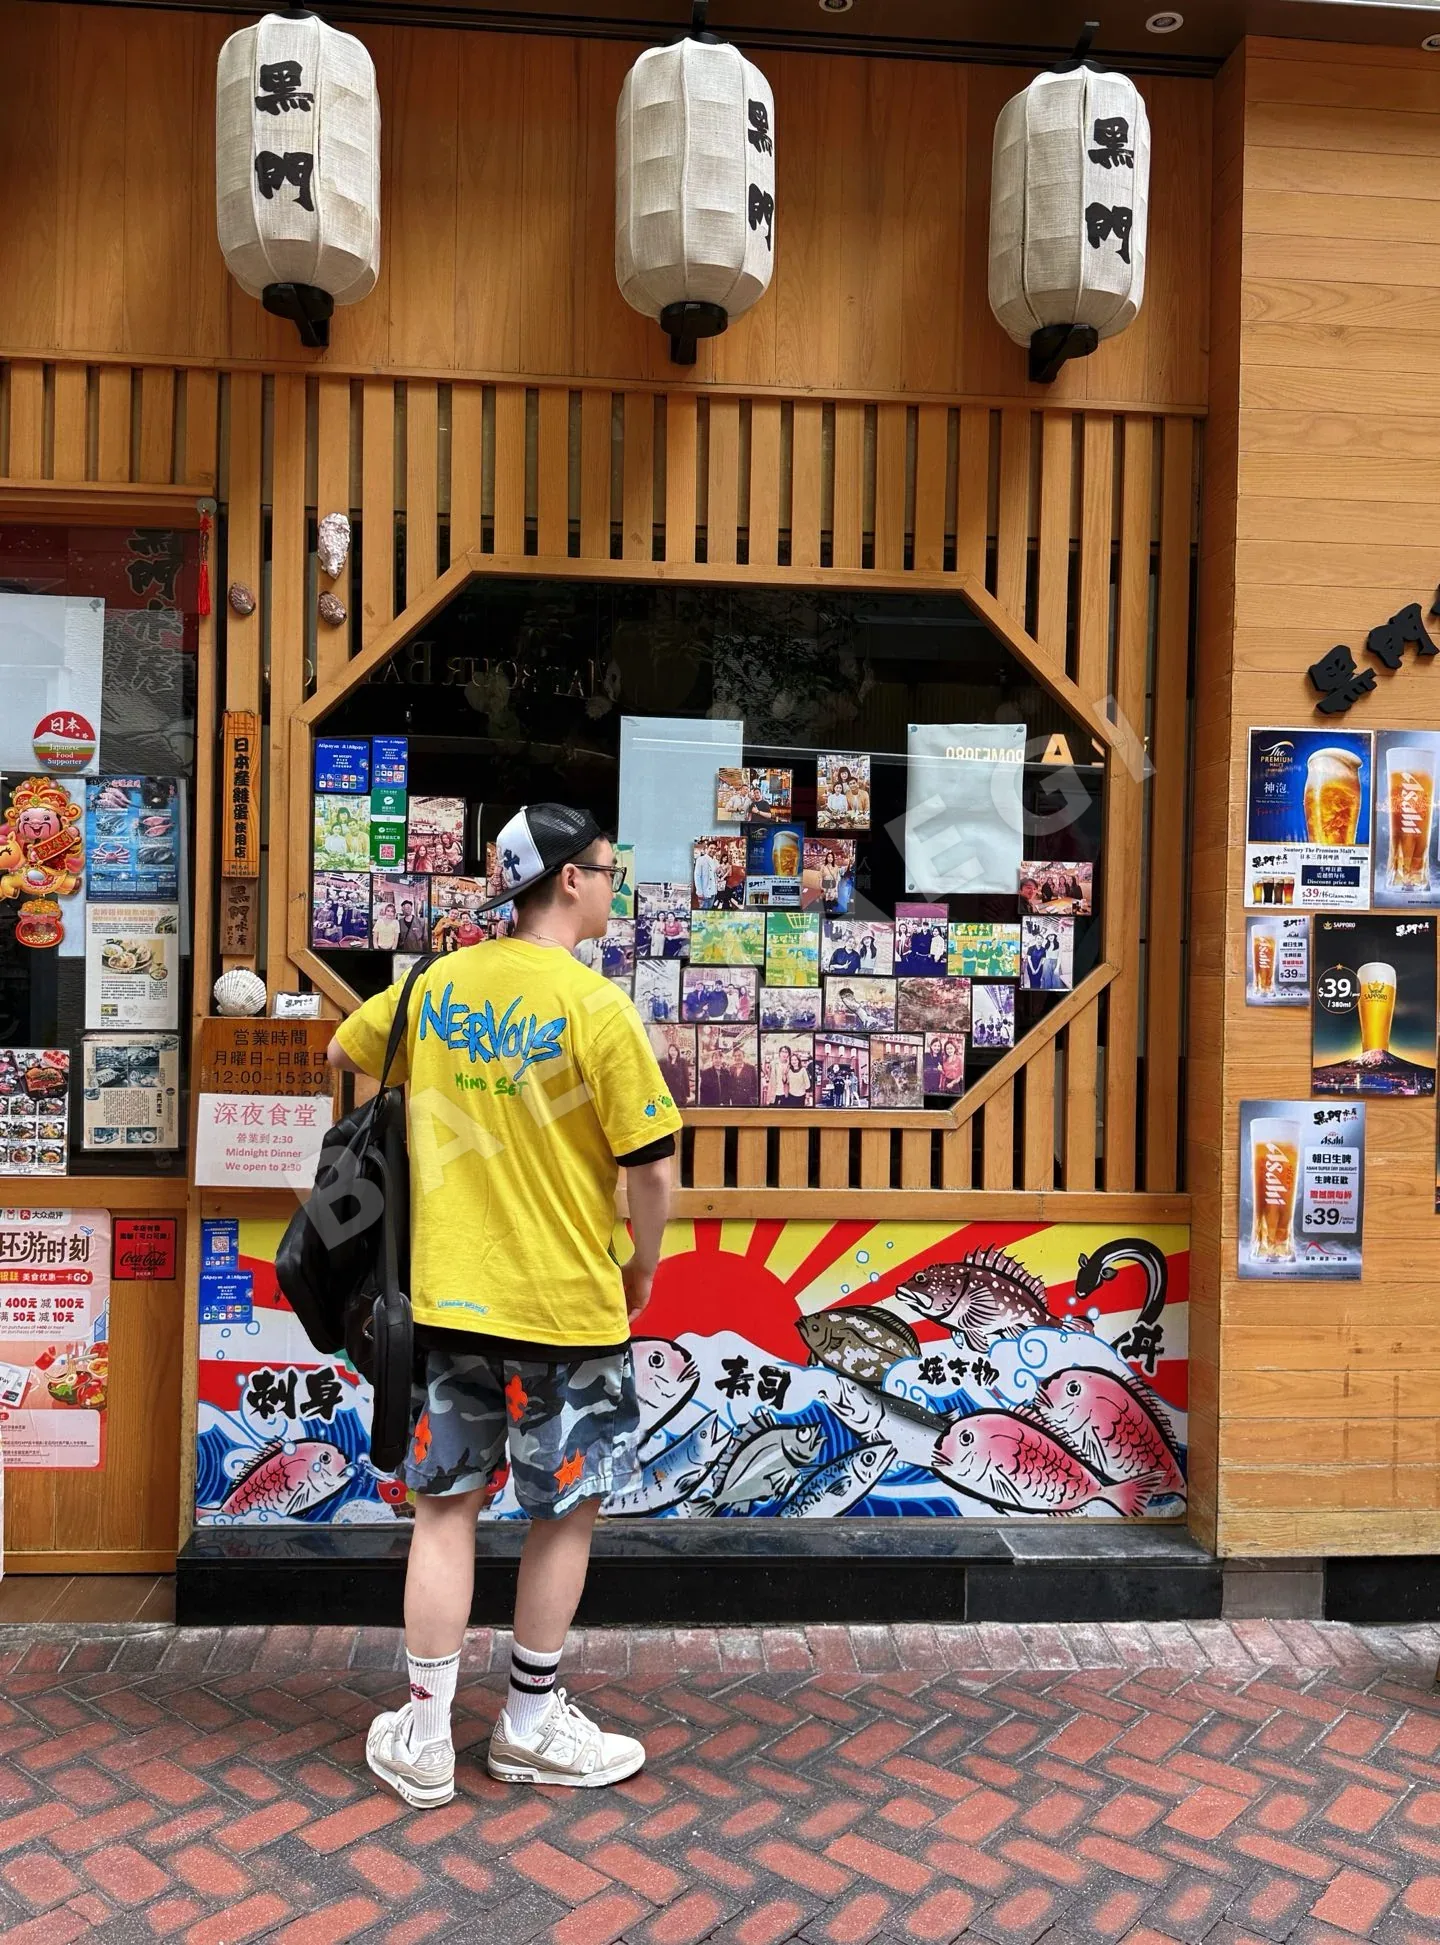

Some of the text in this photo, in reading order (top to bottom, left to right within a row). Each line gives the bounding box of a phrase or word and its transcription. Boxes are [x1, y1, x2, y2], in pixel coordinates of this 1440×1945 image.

[51, 716, 80, 733] 日本
[49, 743, 80, 752] Japanese
[56, 751, 74, 759] Food
[47, 758, 82, 766] Supporter
[1400, 772, 1425, 835] Asahi
[1280, 969, 1298, 979] $39
[1318, 978, 1351, 998] $39
[234, 1029, 308, 1046] 営業時間
[420, 981, 567, 1081] NERVOUS
[213, 1070, 324, 1085] 12:00~15:30
[214, 1102, 317, 1127] 深夜食堂
[272, 1135, 293, 1144] 2:30
[1320, 1135, 1344, 1145] Asahi
[225, 1148, 302, 1159] Midnight Dinner
[225, 1162, 302, 1172] We open to 2:30
[1264, 1142, 1290, 1206] Asahi
[32, 1211, 64, 1220] 大众点评
[5, 1297, 85, 1309] 400元 减 100元
[13, 1312, 36, 1322] 50元
[38, 1311, 50, 1322] 减
[52, 1312, 75, 1322] 10元
[917, 1355, 1000, 1387] 焼き物
[714, 1354, 792, 1410] 寿司
[246, 1366, 343, 1420] 刺身
